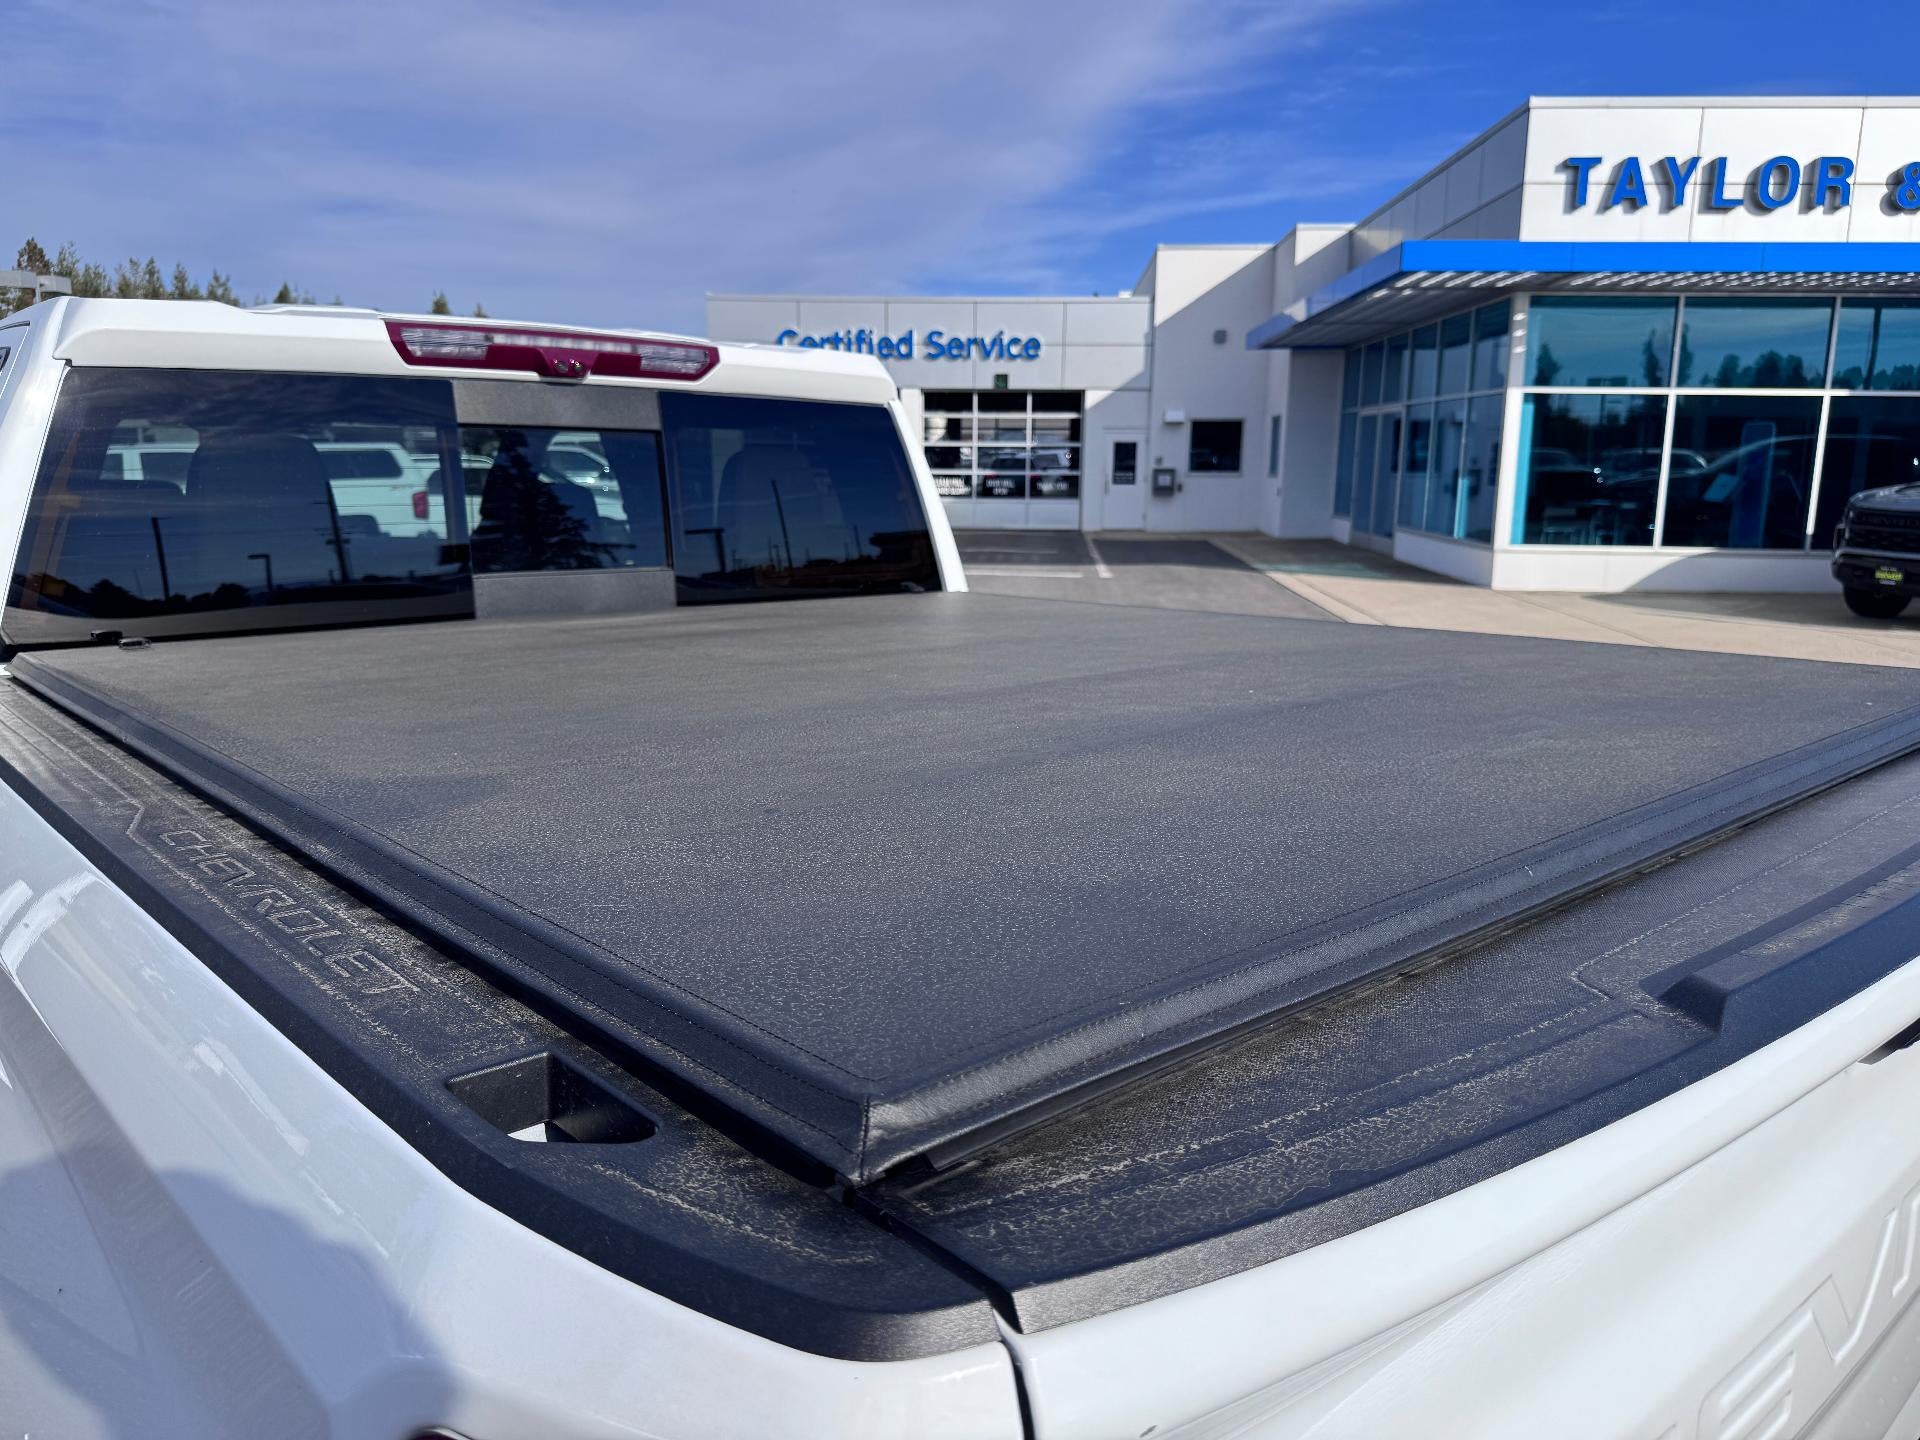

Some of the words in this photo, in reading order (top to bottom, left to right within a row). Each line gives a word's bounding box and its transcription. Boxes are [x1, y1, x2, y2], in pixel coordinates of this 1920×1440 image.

[1564, 156, 1855, 211] TAYLOR
[927, 330, 1041, 360] Service
[159, 829, 420, 994] CHEVROLET
